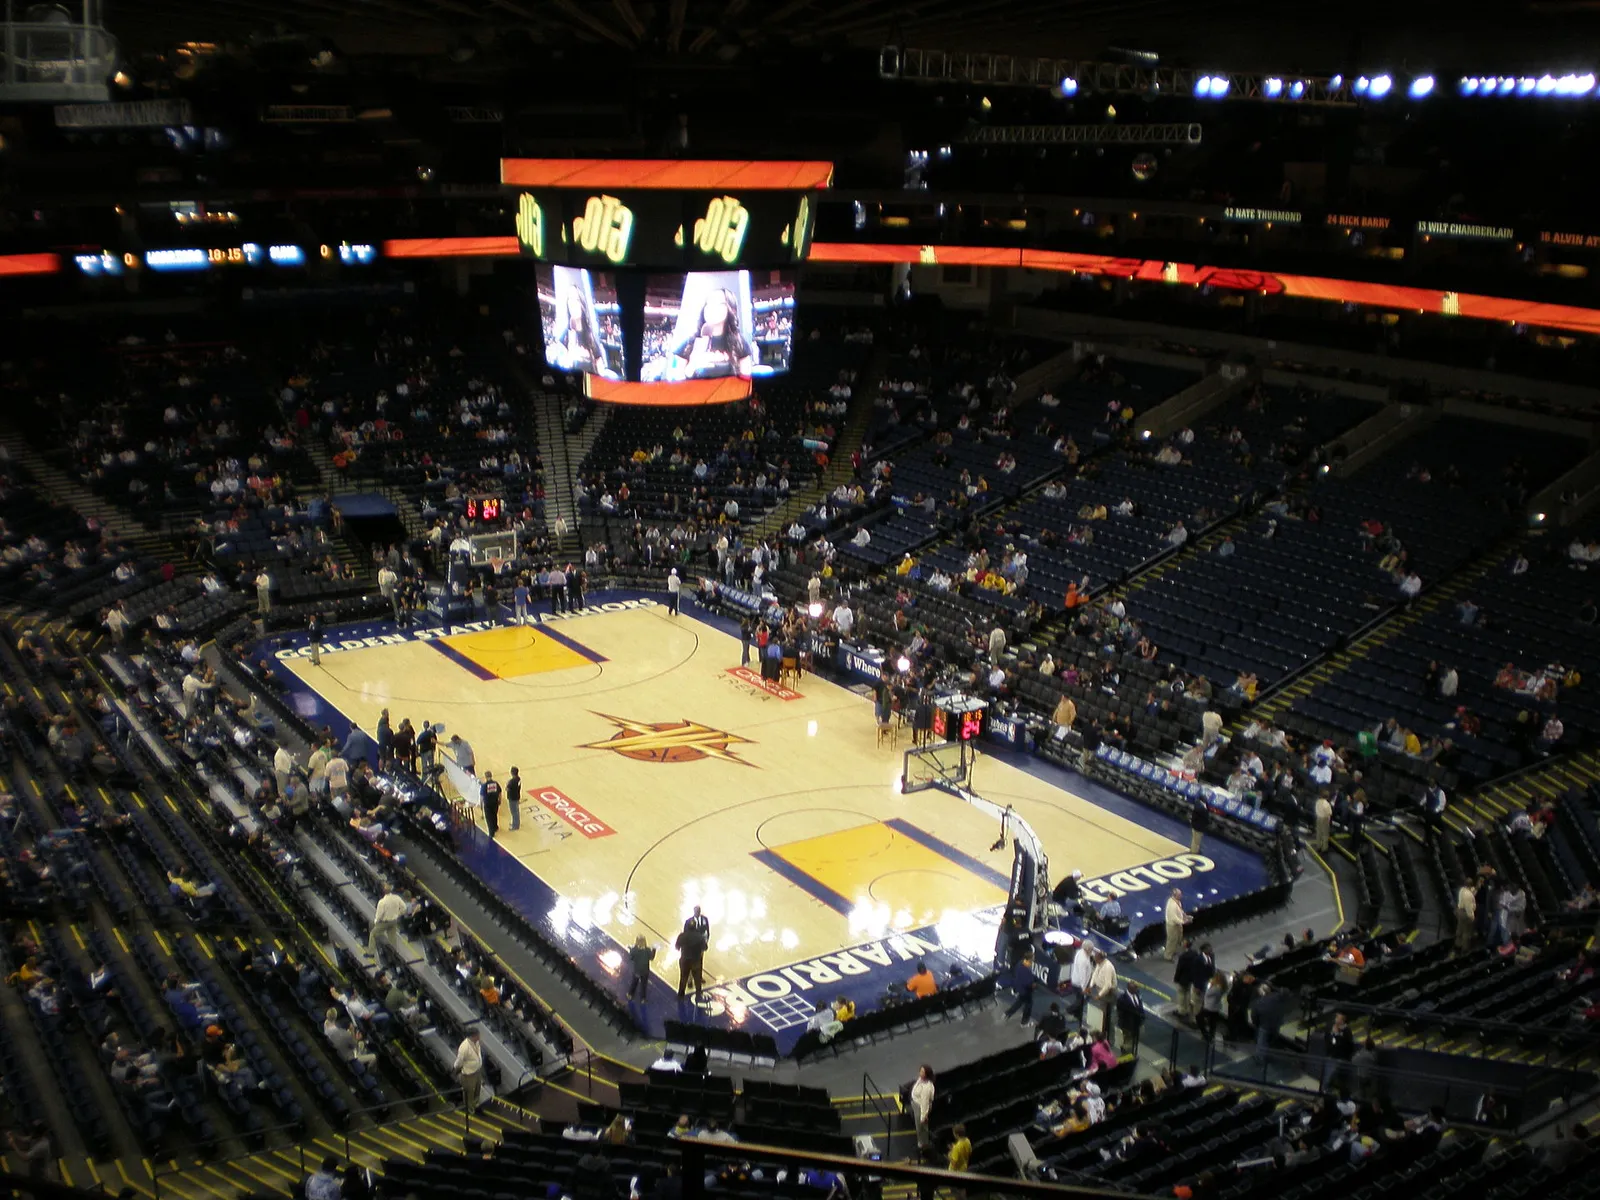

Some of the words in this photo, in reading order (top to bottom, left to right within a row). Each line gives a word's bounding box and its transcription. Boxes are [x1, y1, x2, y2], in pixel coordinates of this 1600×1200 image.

[1235, 208, 1255, 220] NATE
[1256, 209, 1302, 222] THURMOND
[1339, 215, 1359, 227] RICK
[1361, 216, 1391, 229] BARRY
[1428, 221, 1449, 234] WILT
[1449, 222, 1514, 239] CHAMBERLAIN
[1552, 232, 1584, 246] ALVIN
[274, 633, 407, 660] GOLDEN
[539, 791, 605, 834] ORACLE
[690, 932, 943, 1017] WARRIORS
